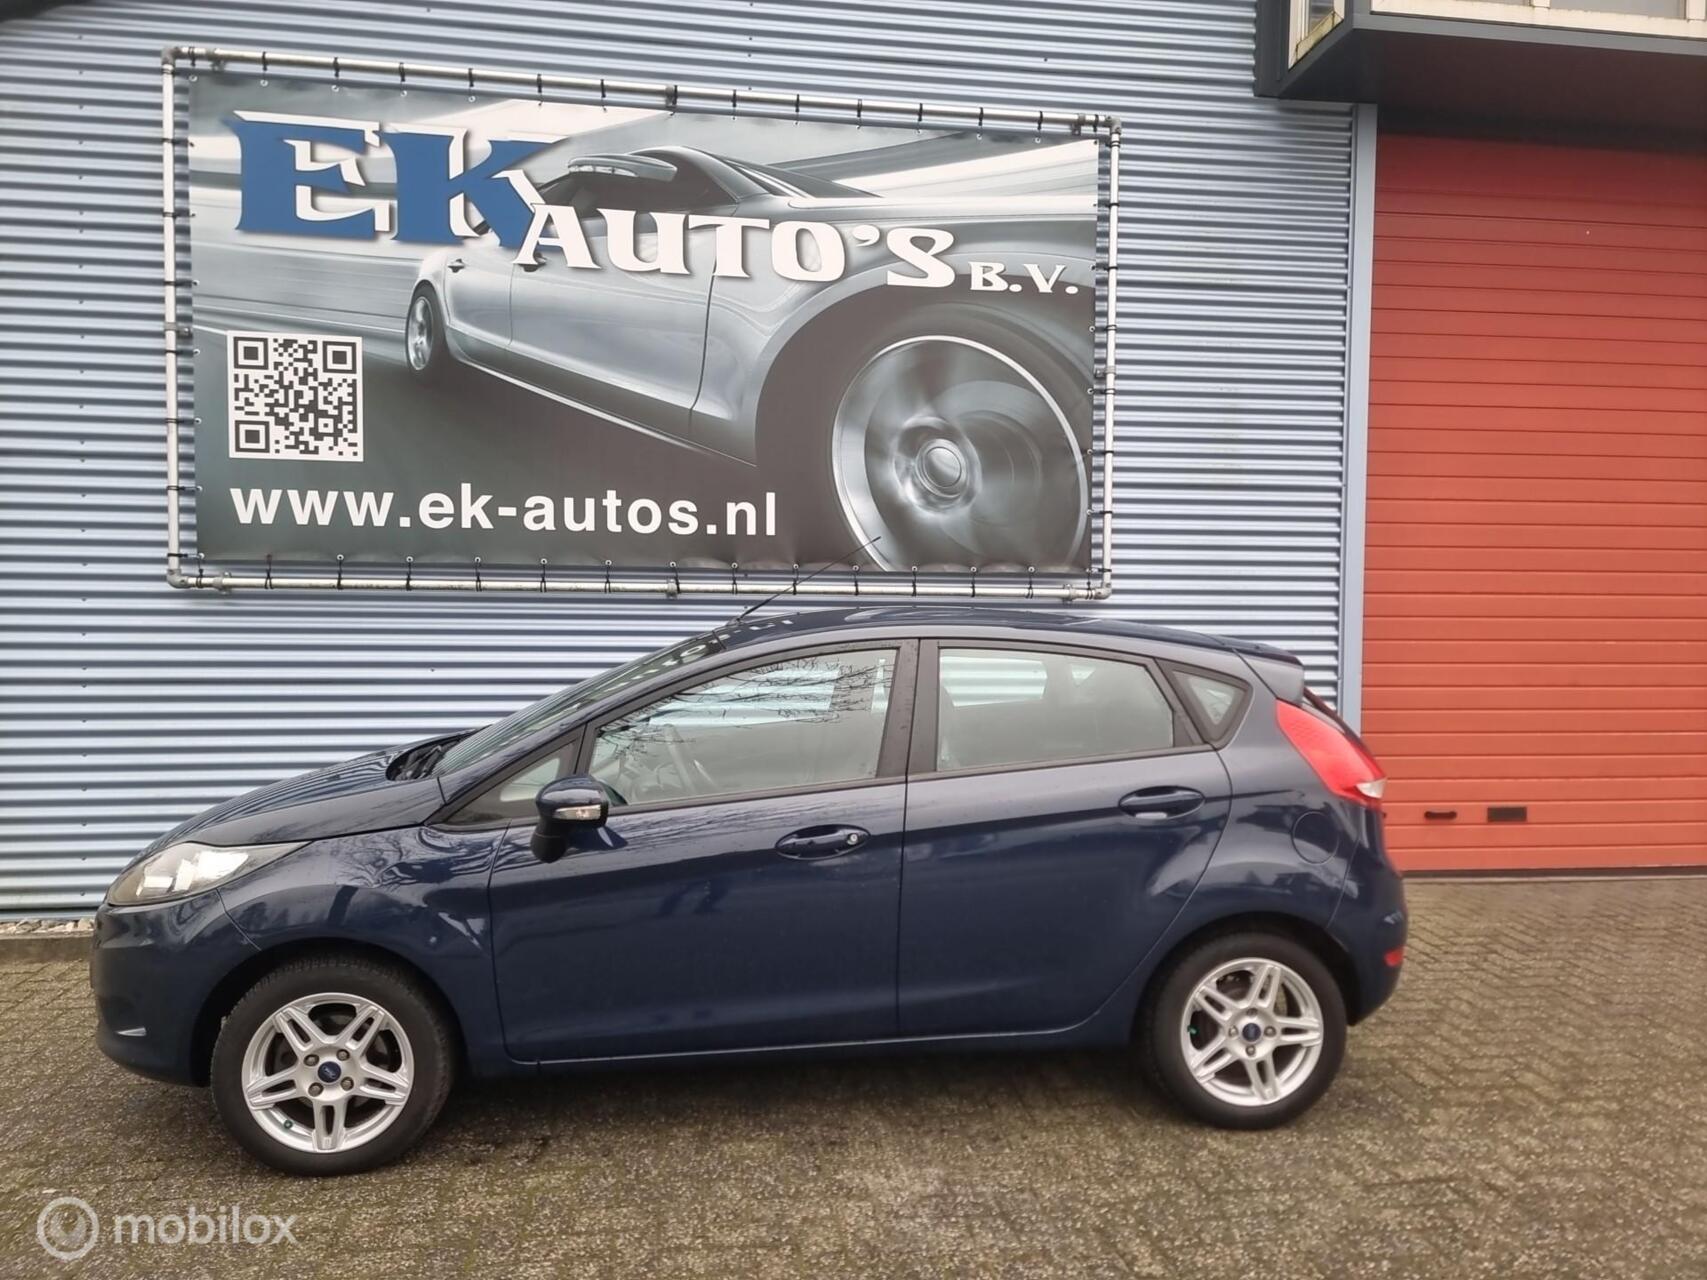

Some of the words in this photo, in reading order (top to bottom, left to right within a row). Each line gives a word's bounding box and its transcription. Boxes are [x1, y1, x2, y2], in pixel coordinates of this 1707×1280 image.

[223, 110, 567, 249] EK
[511, 204, 955, 288] AUTO'S
[969, 261, 1078, 294] B.V.
[230, 483, 776, 537] www.ek-autos.nl
